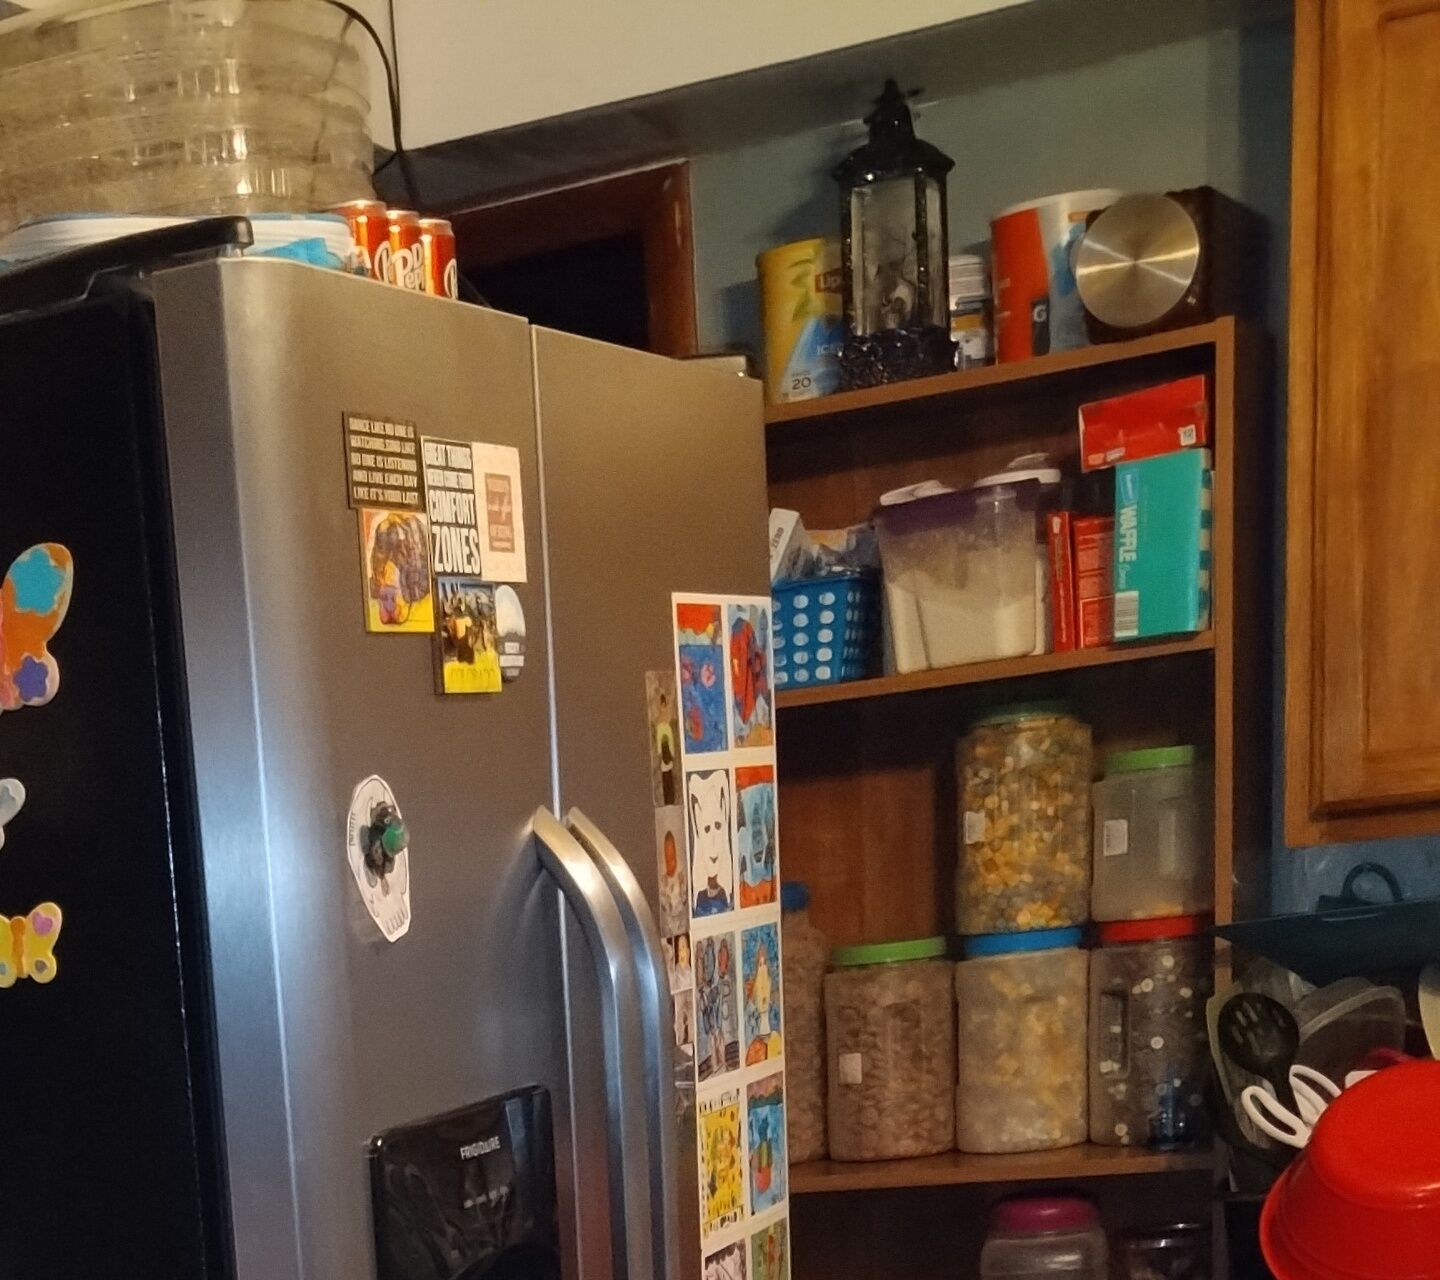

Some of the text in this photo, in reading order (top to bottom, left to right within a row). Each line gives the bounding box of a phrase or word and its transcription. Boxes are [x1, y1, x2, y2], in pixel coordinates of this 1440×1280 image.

[1032, 304, 1047, 322] G
[792, 376, 812, 390] 20
[385, 473, 403, 486] EACH
[404, 474, 417, 488] DAY
[353, 486, 369, 500] LIKE
[428, 489, 475, 525] COMFORT
[1118, 505, 1137, 562] WAFFLE
[432, 526, 481, 574] ZONES
[460, 1135, 501, 1160] FRIGIDAIRE
